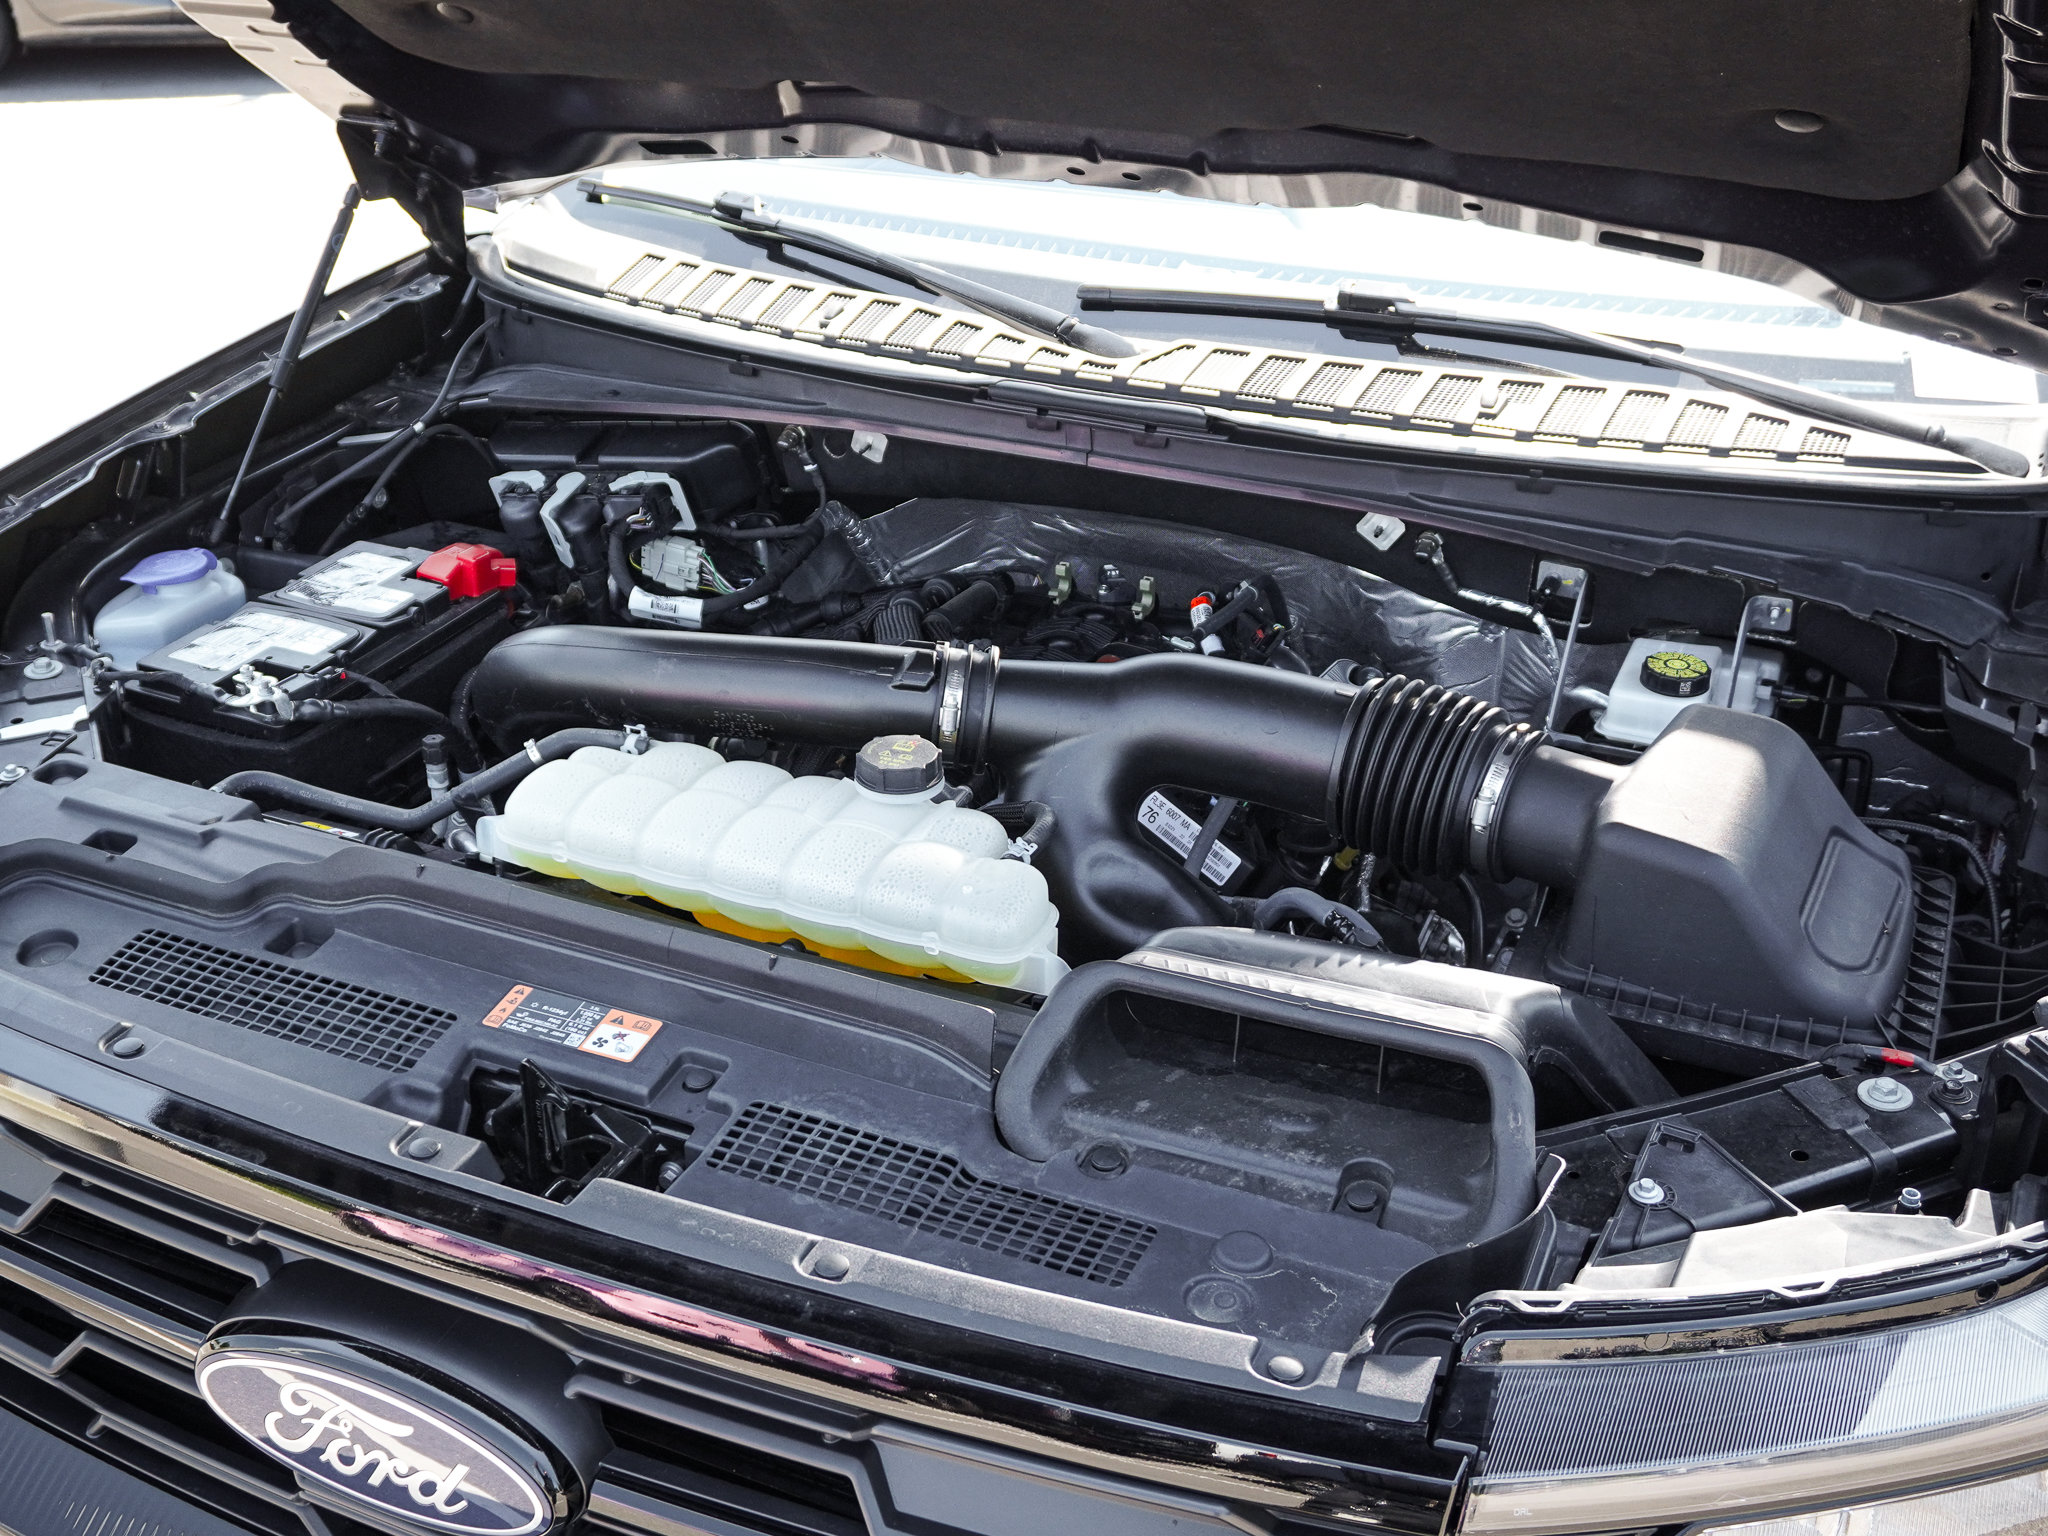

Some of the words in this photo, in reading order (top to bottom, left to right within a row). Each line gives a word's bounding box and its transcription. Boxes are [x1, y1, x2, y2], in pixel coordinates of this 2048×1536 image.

[1141, 805, 1159, 824] 76
[1165, 807, 1181, 822] 6007
[1179, 819, 1191, 831] MA
[501, 1022, 528, 1032] FoMoCo
[264, 1381, 468, 1515] Ford
[1513, 1507, 1533, 1516] DRL
